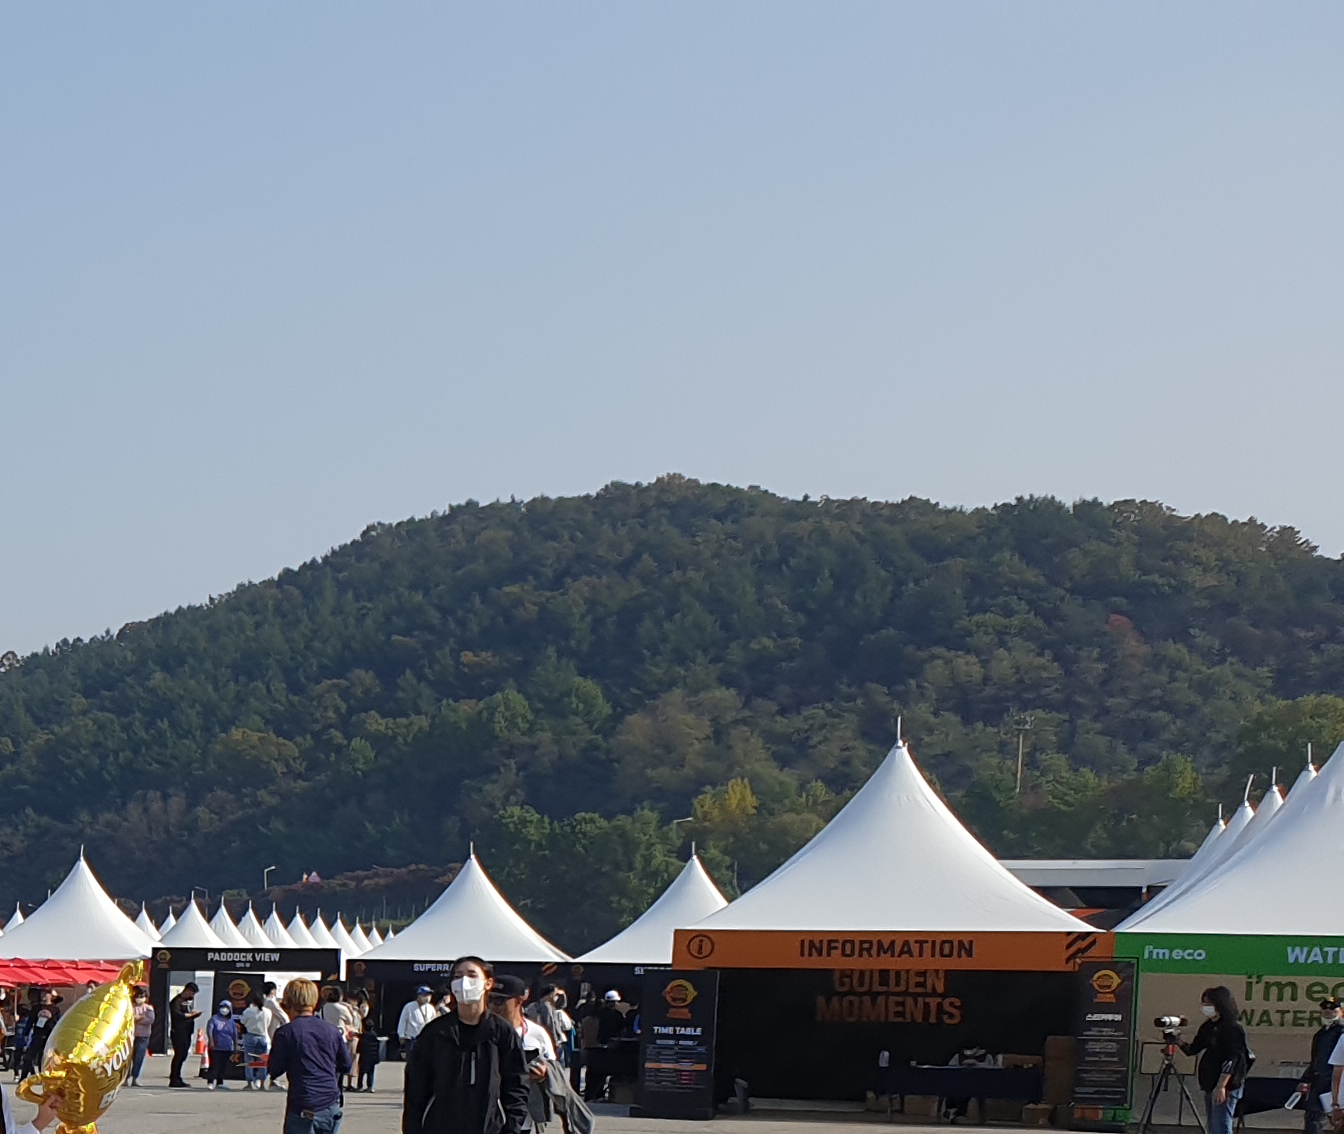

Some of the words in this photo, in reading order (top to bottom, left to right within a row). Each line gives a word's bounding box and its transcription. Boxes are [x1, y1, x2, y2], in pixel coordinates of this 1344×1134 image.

[207, 952, 253, 962] PADDOCK
[254, 953, 280, 962] VIEW
[799, 939, 975, 959] INFORMATION
[1171, 948, 1206, 961] eco
[833, 968, 945, 993] GOLDEN
[816, 995, 962, 1025] MOMENTS
[653, 1026, 674, 1035] TIME
[675, 1027, 703, 1036] TABLE
